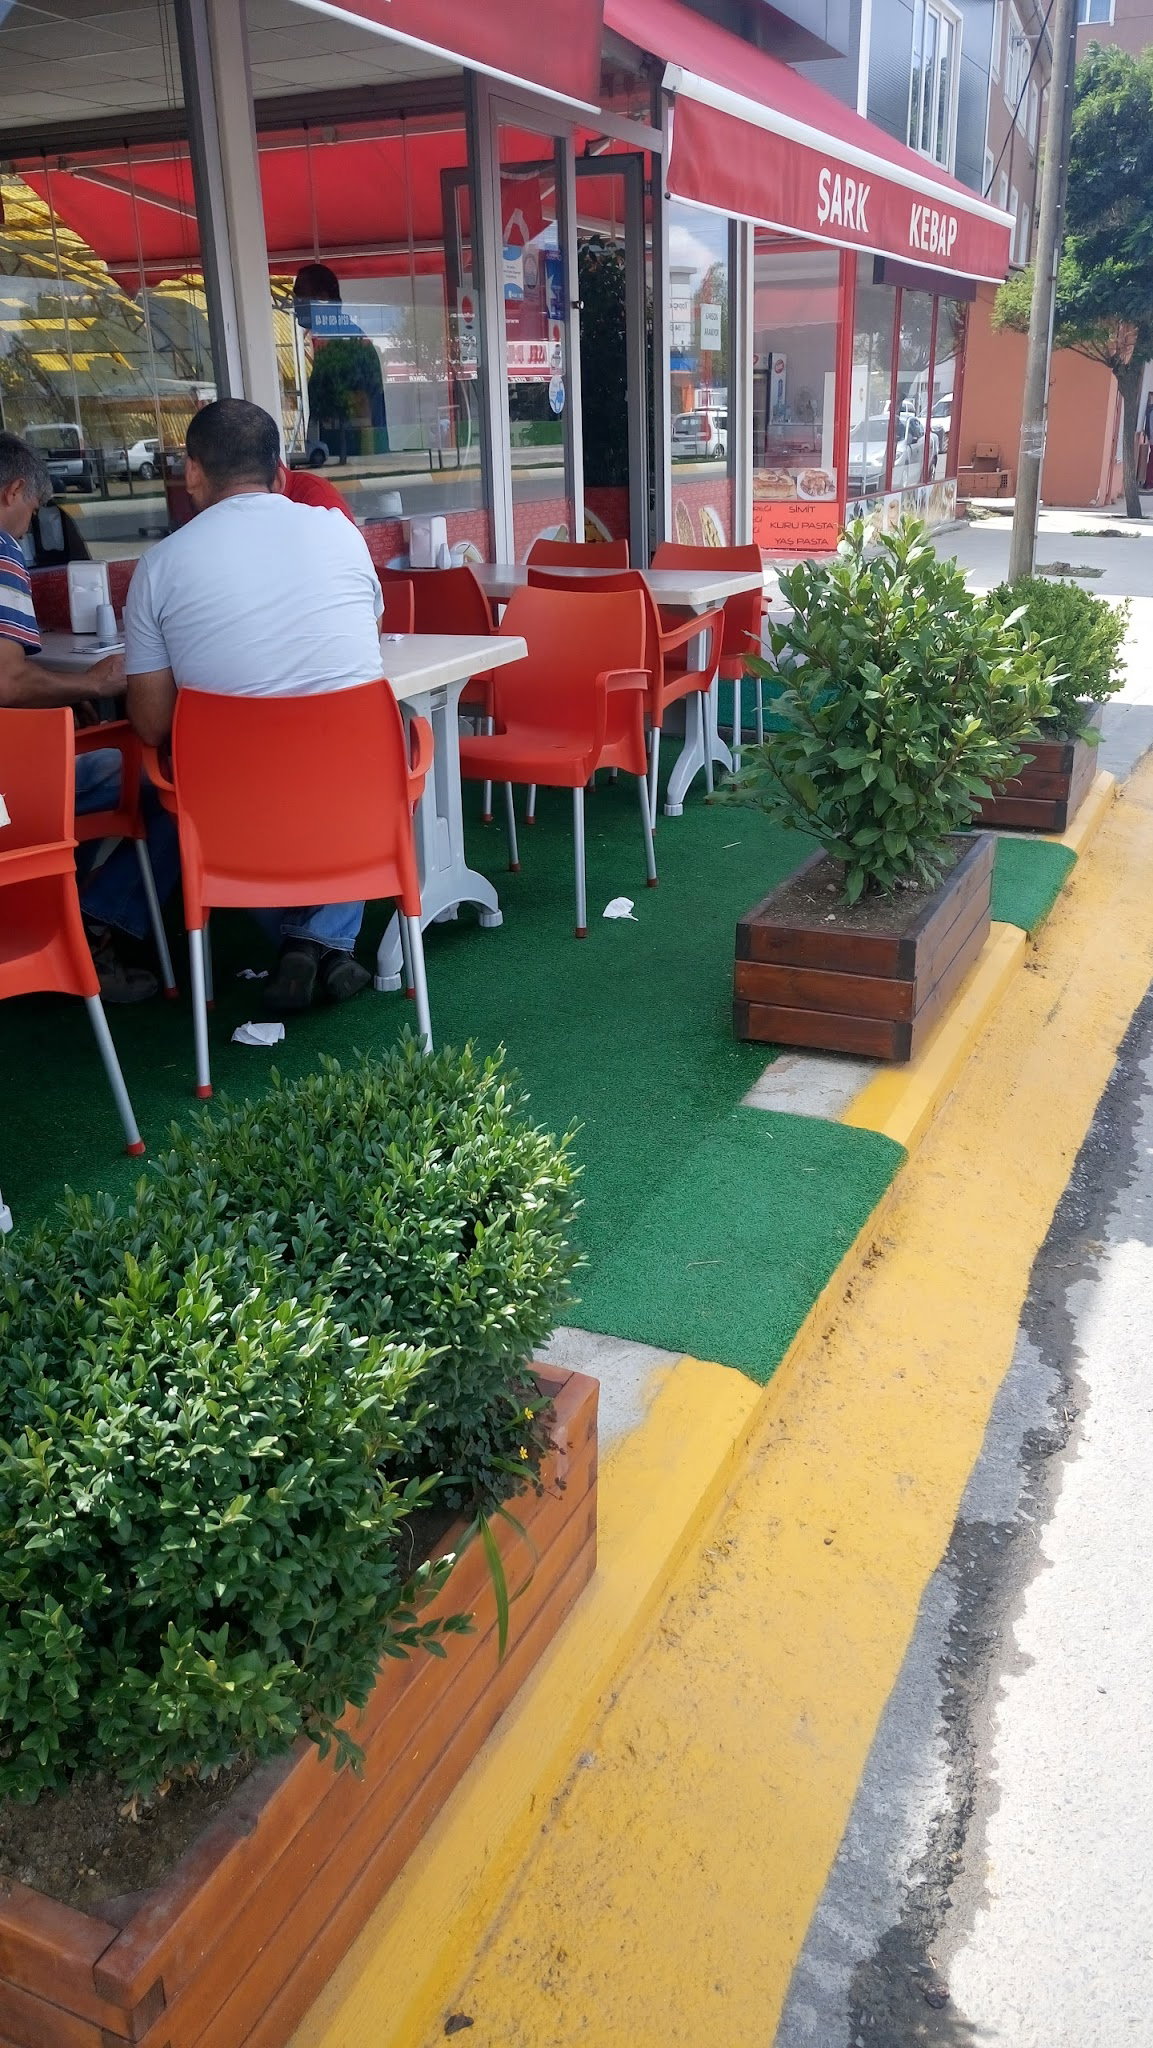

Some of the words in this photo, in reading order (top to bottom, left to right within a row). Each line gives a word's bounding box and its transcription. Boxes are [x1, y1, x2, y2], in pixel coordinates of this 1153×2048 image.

[817, 167, 871, 233] ŞARK
[909, 203, 958, 257] KEBAP
[769, 521, 800, 529] KURU
[801, 522, 834, 530] PASTA
[774, 538, 794, 546] YAŞ
[796, 538, 829, 546] PASTA
